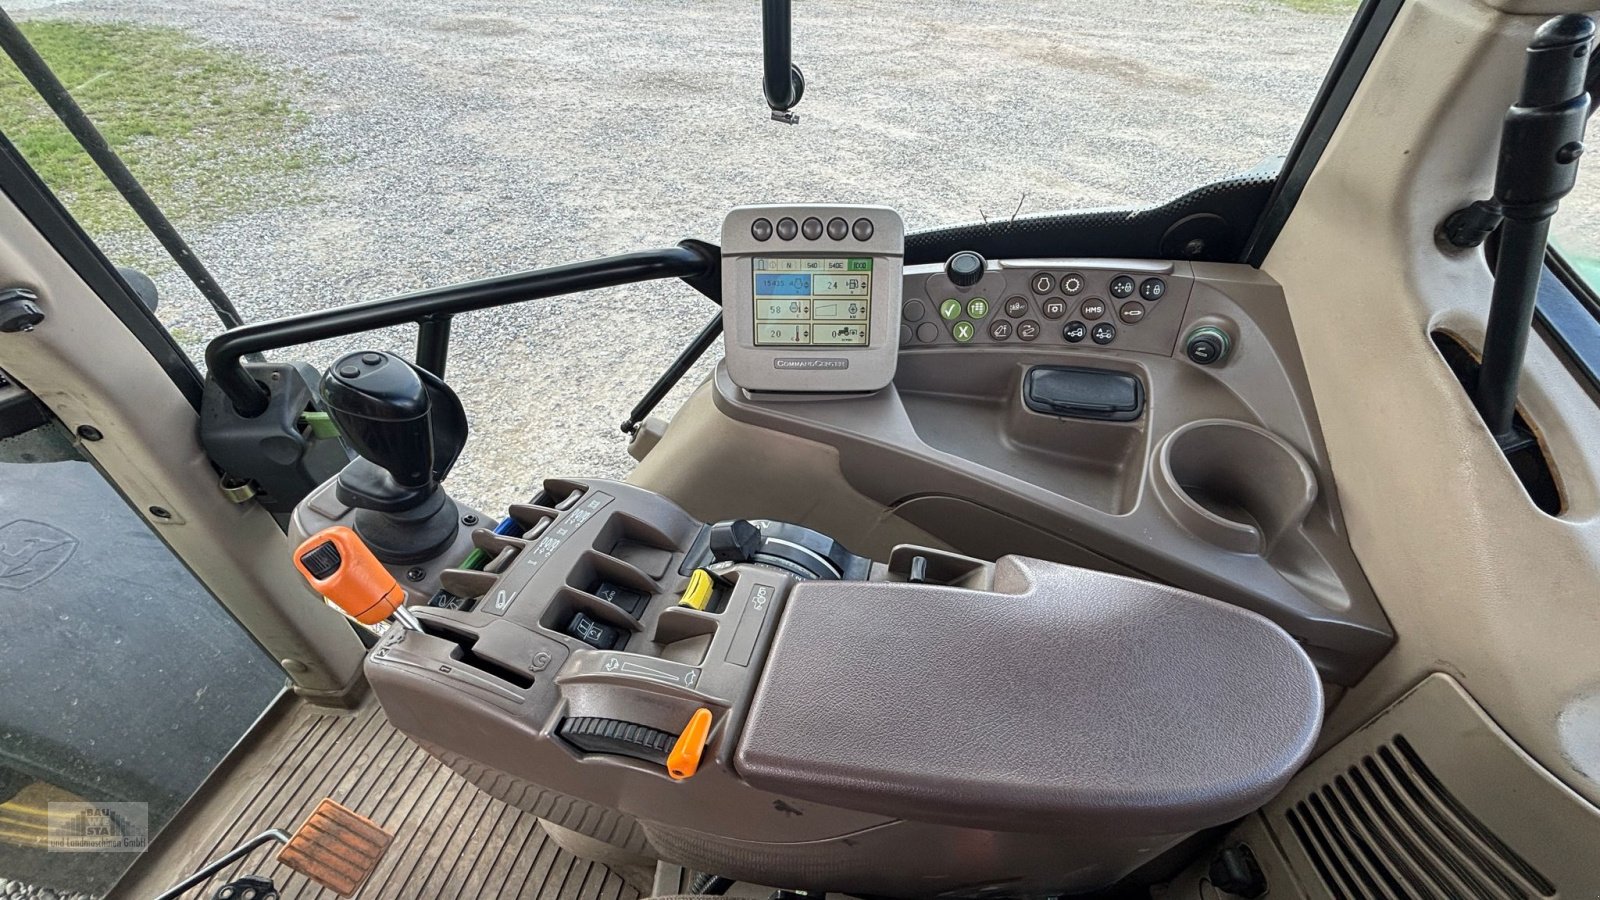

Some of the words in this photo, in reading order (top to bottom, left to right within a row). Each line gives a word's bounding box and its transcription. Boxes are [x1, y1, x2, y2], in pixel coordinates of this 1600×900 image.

[827, 281, 838, 290] 24
[769, 306, 781, 314] 58
[770, 330, 782, 338] 20
